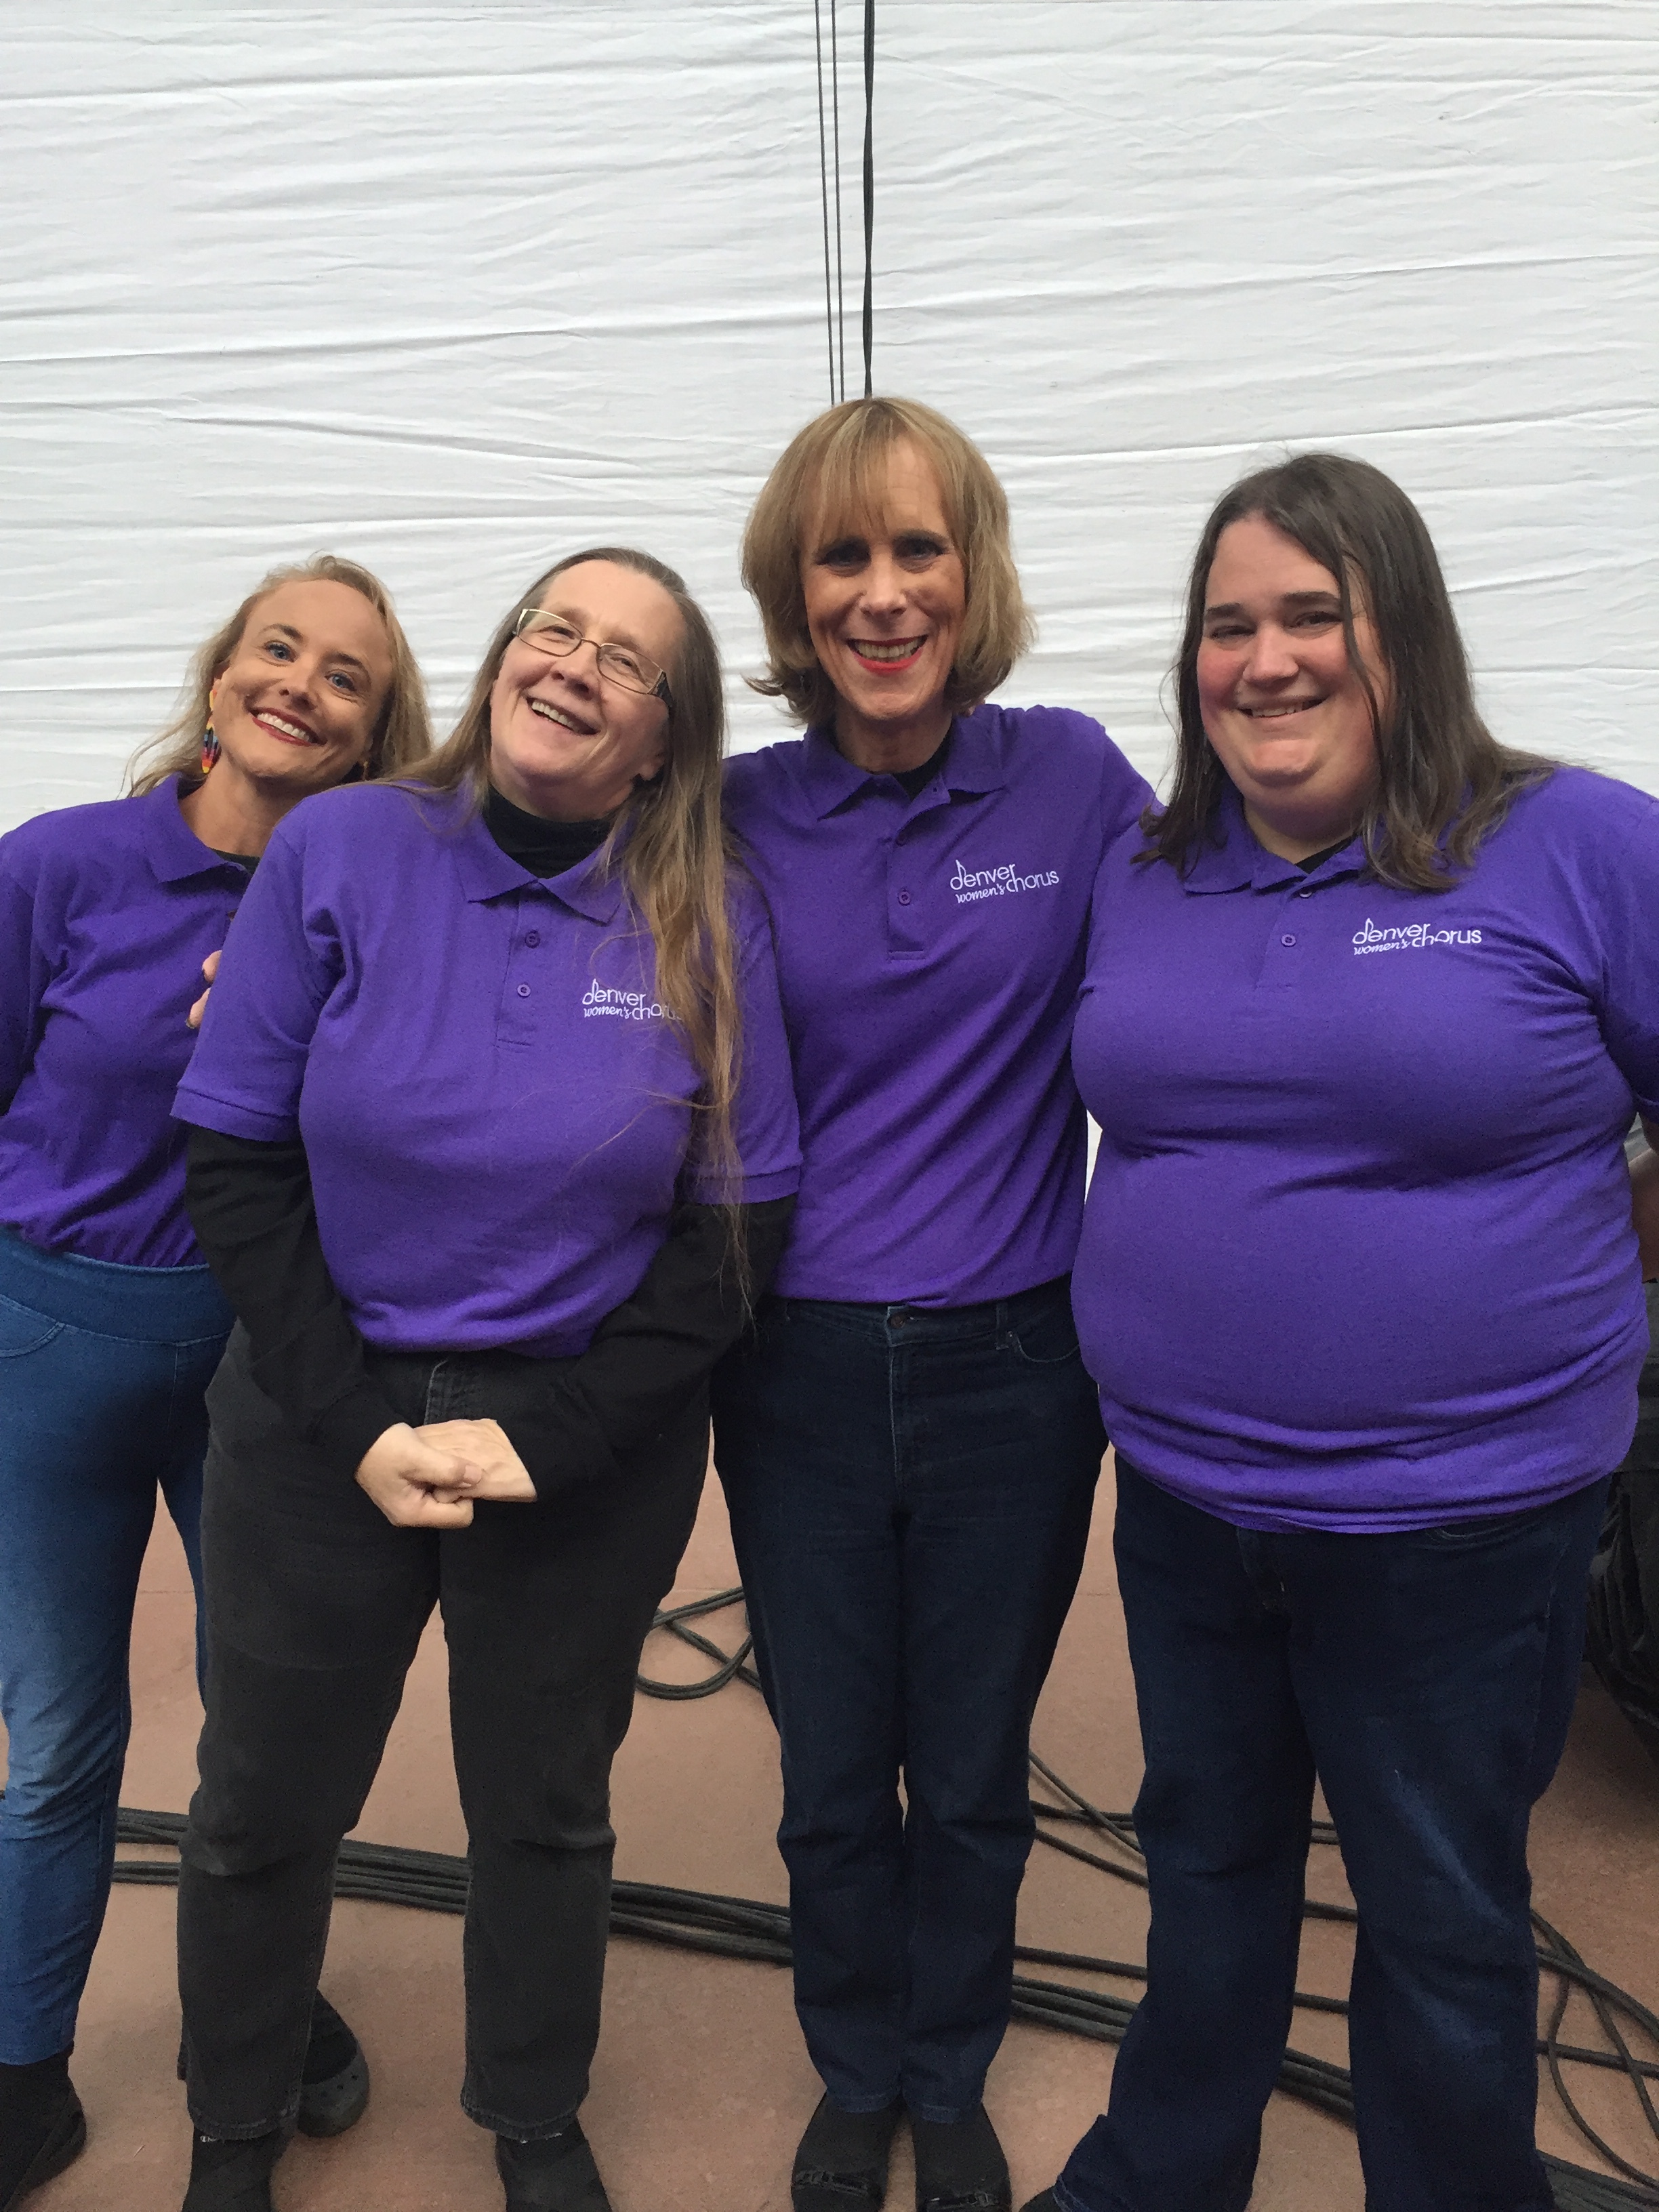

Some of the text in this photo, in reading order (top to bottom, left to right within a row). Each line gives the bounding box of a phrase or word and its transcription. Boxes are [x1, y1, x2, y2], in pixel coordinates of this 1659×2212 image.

[950, 859, 1015, 890] denver
[955, 869, 1059, 903] women's chorus
[1351, 918, 1431, 944] denver
[1354, 929, 1482, 955] women's chorus
[582, 978, 646, 1006] denver
[583, 1006, 632, 1019] women's
